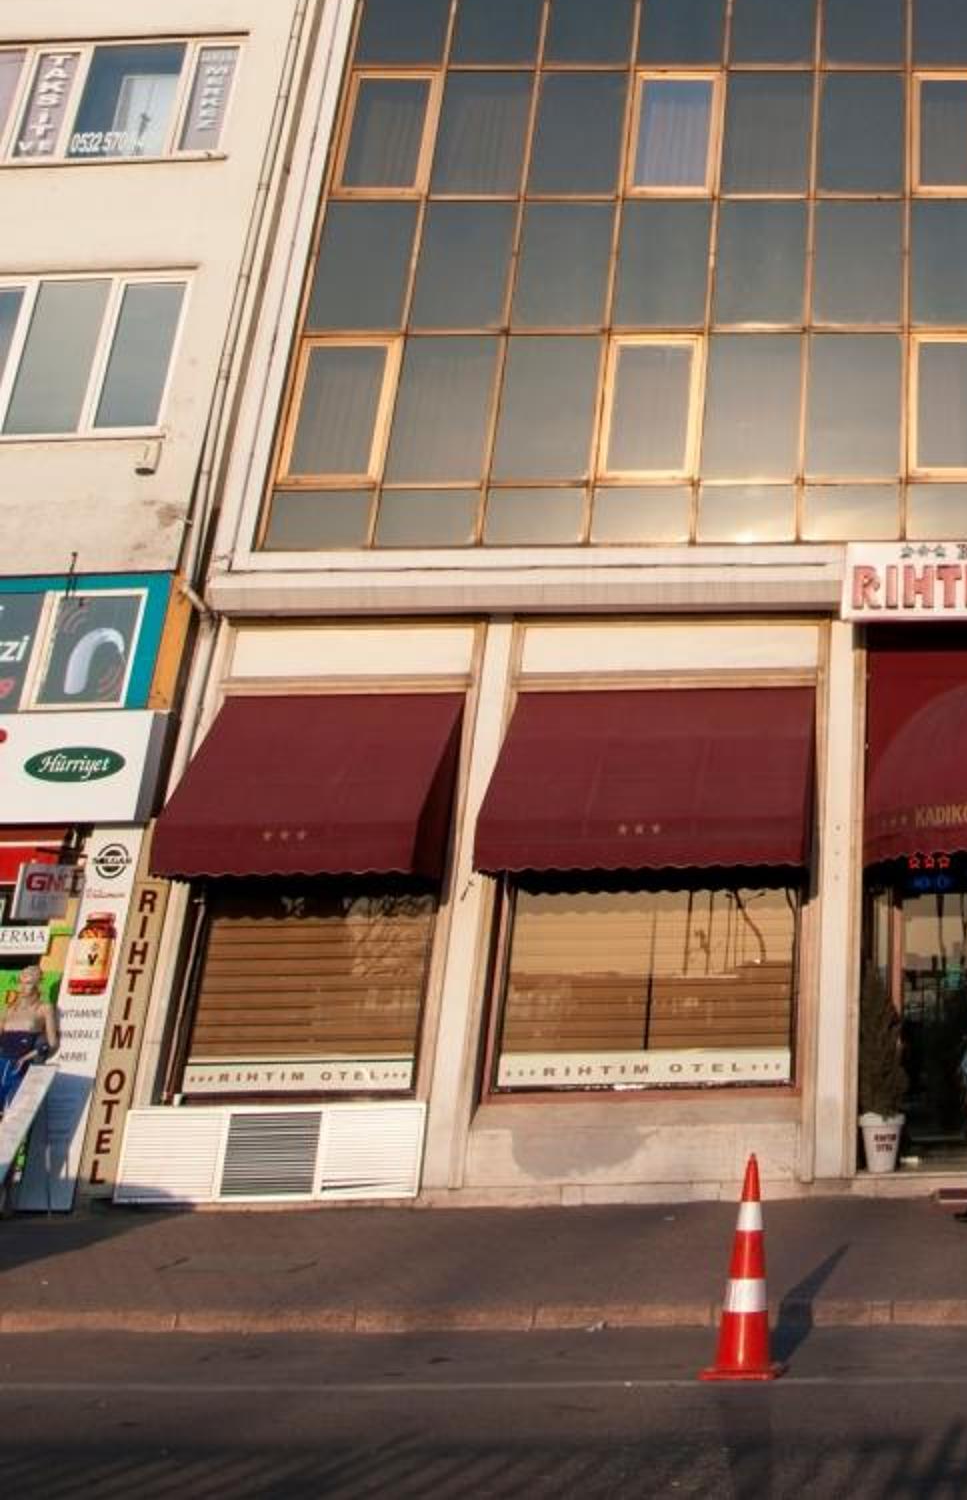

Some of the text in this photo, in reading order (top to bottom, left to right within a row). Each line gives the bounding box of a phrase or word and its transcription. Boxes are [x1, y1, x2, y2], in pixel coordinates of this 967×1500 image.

[38, 753, 110, 780] Hürriyet
[110, 890, 158, 1050] RIHTIM
[218, 1070, 380, 1082] RIHTIM OTEL
[543, 1062, 744, 1077] RIHTIM OTEL
[89, 1069, 126, 1185] OTEL
